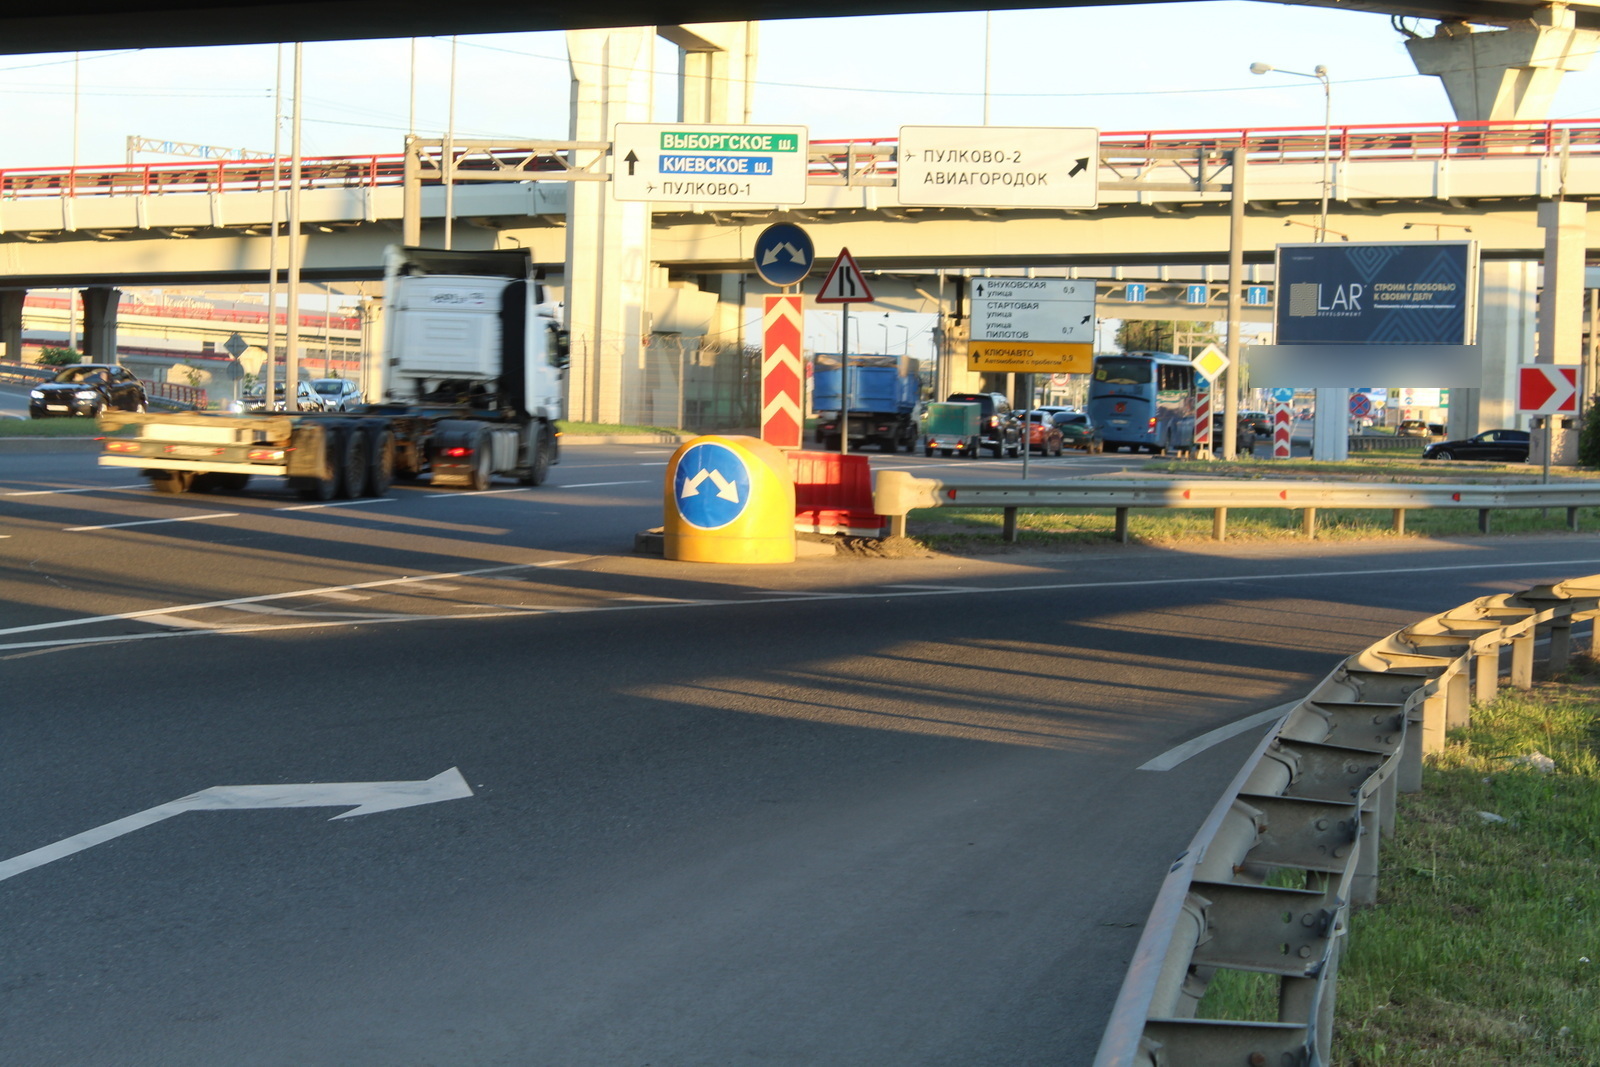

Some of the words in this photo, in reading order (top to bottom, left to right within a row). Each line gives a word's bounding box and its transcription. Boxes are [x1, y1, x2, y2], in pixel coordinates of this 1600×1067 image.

[663, 134, 772, 150] ВЫБОРГСКОЕ
[778, 139, 795, 151] ш.
[923, 150, 1022, 164] ПУЛКОВО-2
[663, 157, 748, 173] КИЕВСКОЕ
[754, 161, 771, 173] ш.
[923, 172, 1048, 187] АВИАГОРОДОК
[662, 182, 751, 196] ПУЛКОВО-1
[987, 281, 1047, 289] ВНУКОВСКАЯ
[1318, 283, 1362, 310] LAR
[986, 302, 1039, 310] СТАРТОВАЯ
[985, 331, 1029, 339] ПИЛОТОВ
[1062, 327, 1074, 335] 0,7
[984, 349, 1035, 357] КЛЮЧАВТО
